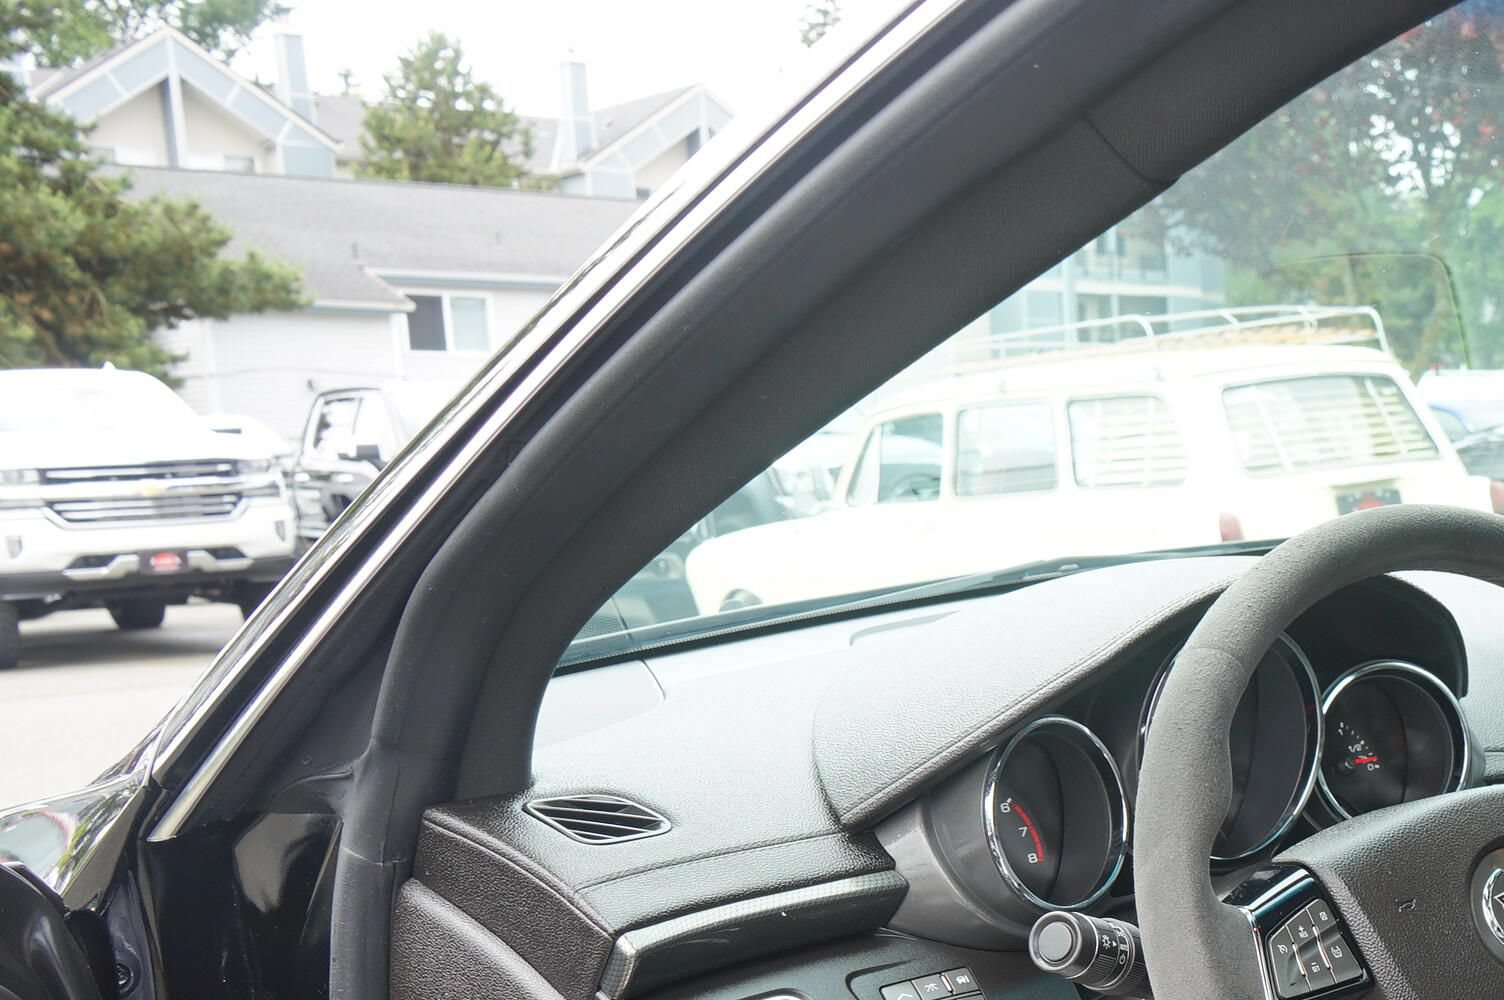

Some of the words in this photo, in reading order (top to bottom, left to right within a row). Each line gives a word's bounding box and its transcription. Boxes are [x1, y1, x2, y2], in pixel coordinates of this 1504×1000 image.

[1000, 802, 1011, 814] 6
[1017, 826, 1028, 838] 7
[1027, 852, 1039, 864] 8
